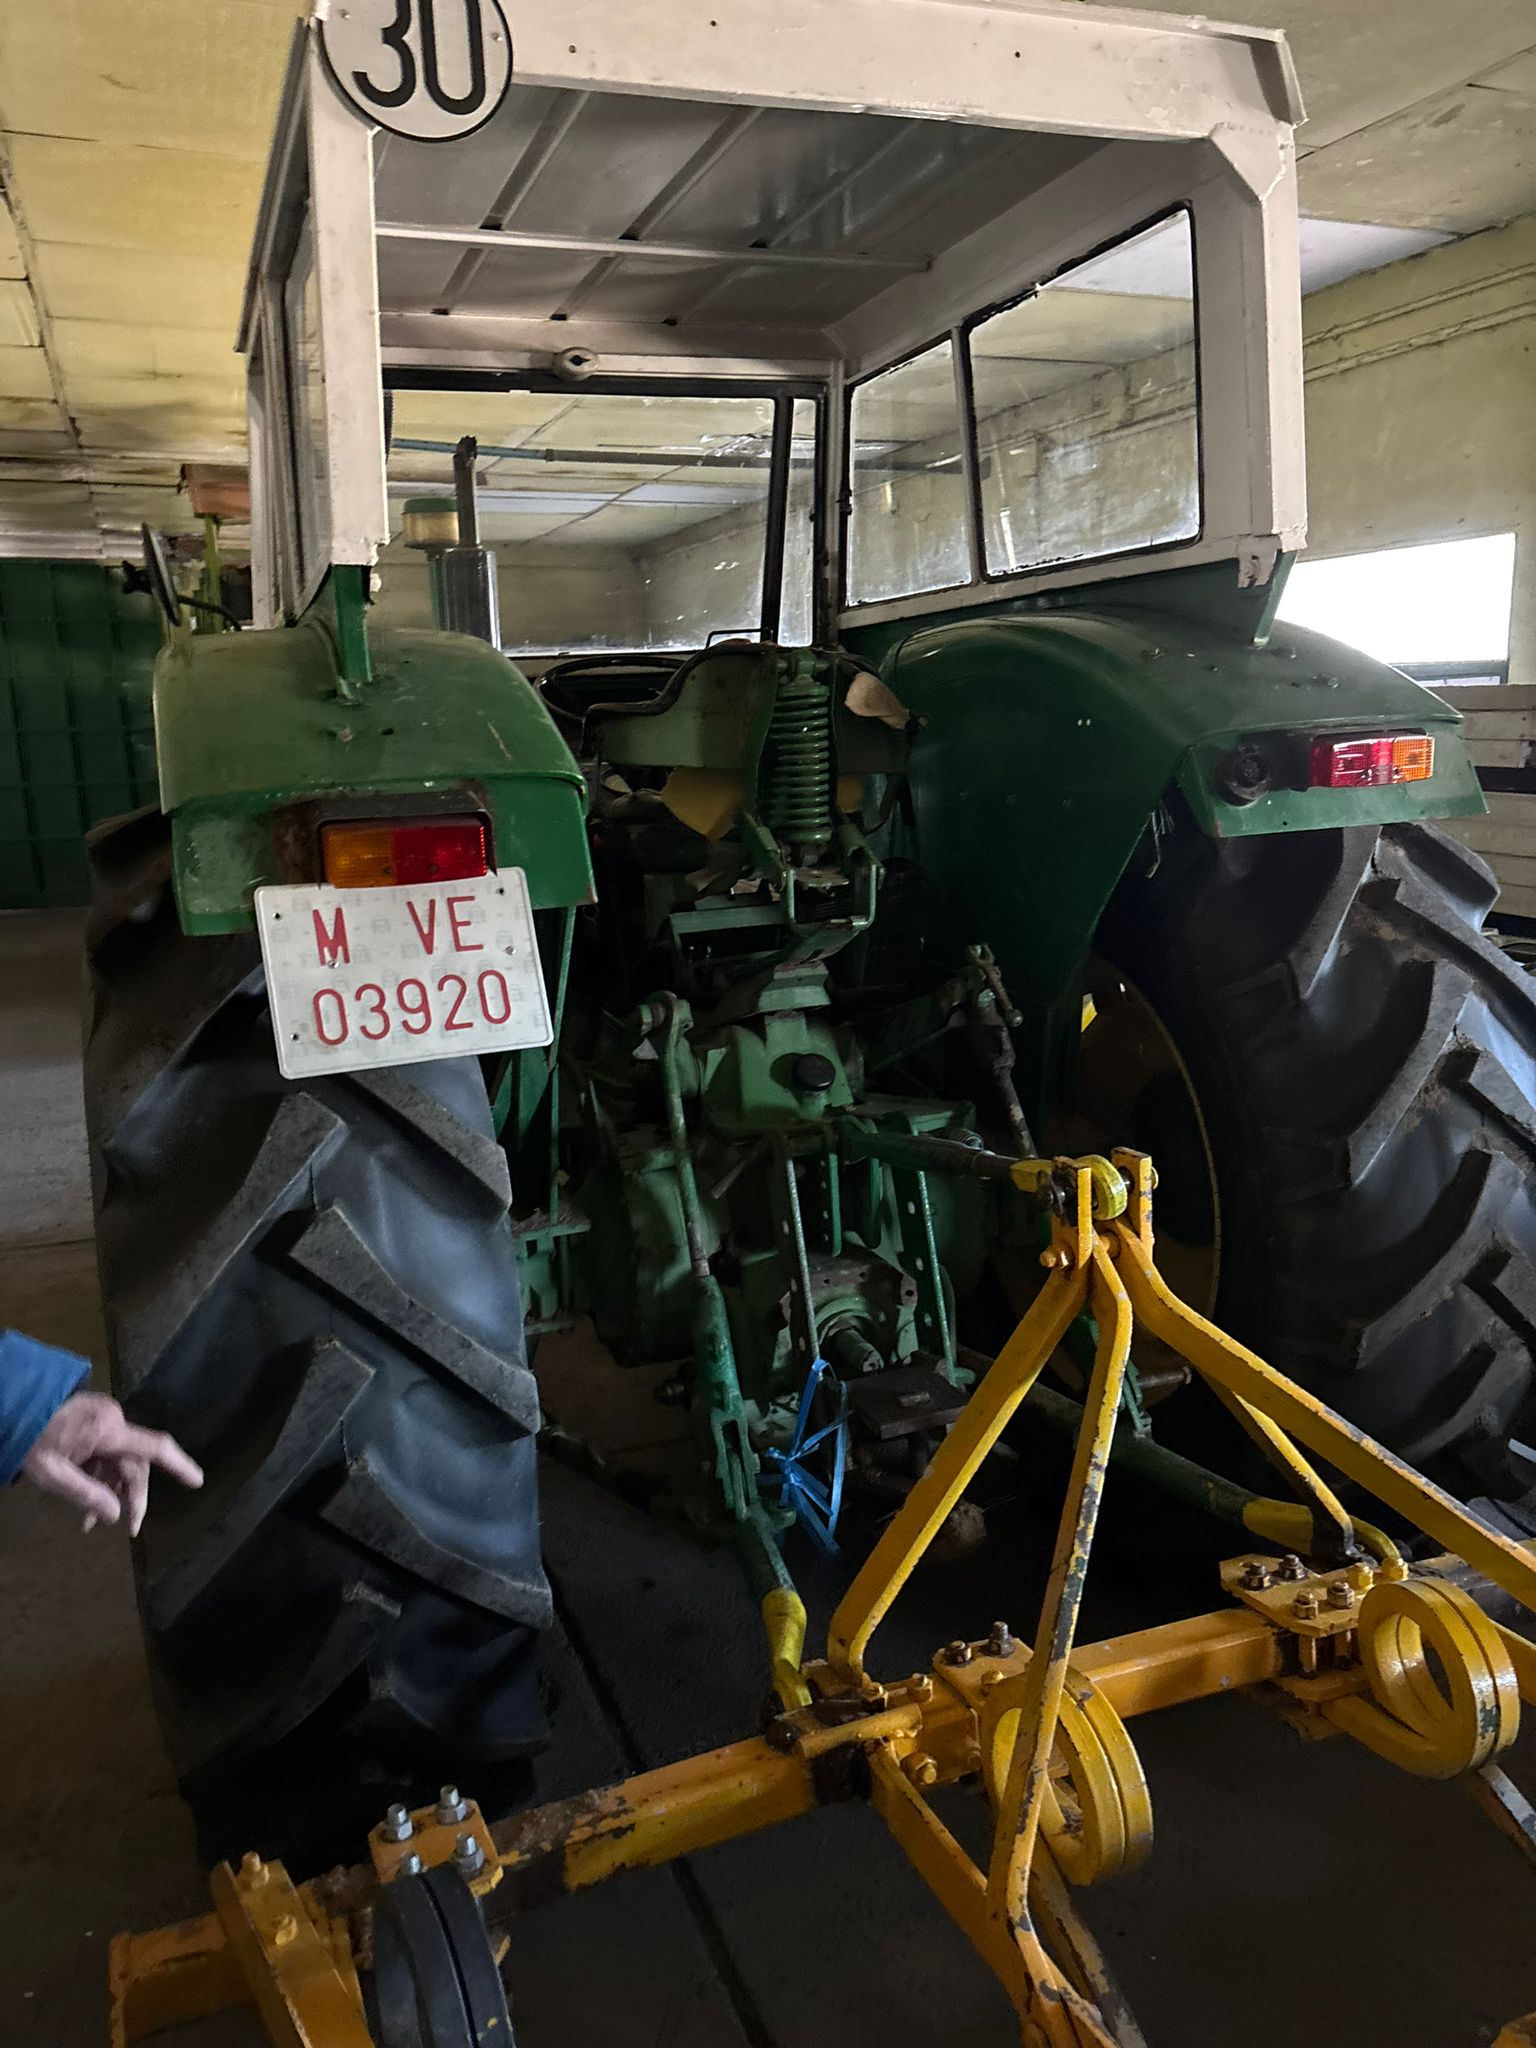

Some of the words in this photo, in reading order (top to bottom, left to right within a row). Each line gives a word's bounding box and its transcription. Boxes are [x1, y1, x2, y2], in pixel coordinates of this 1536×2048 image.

[352, 0, 486, 115] 30
[312, 906, 351, 966] M
[406, 895, 484, 955] VE
[312, 969, 512, 1046] 03920
